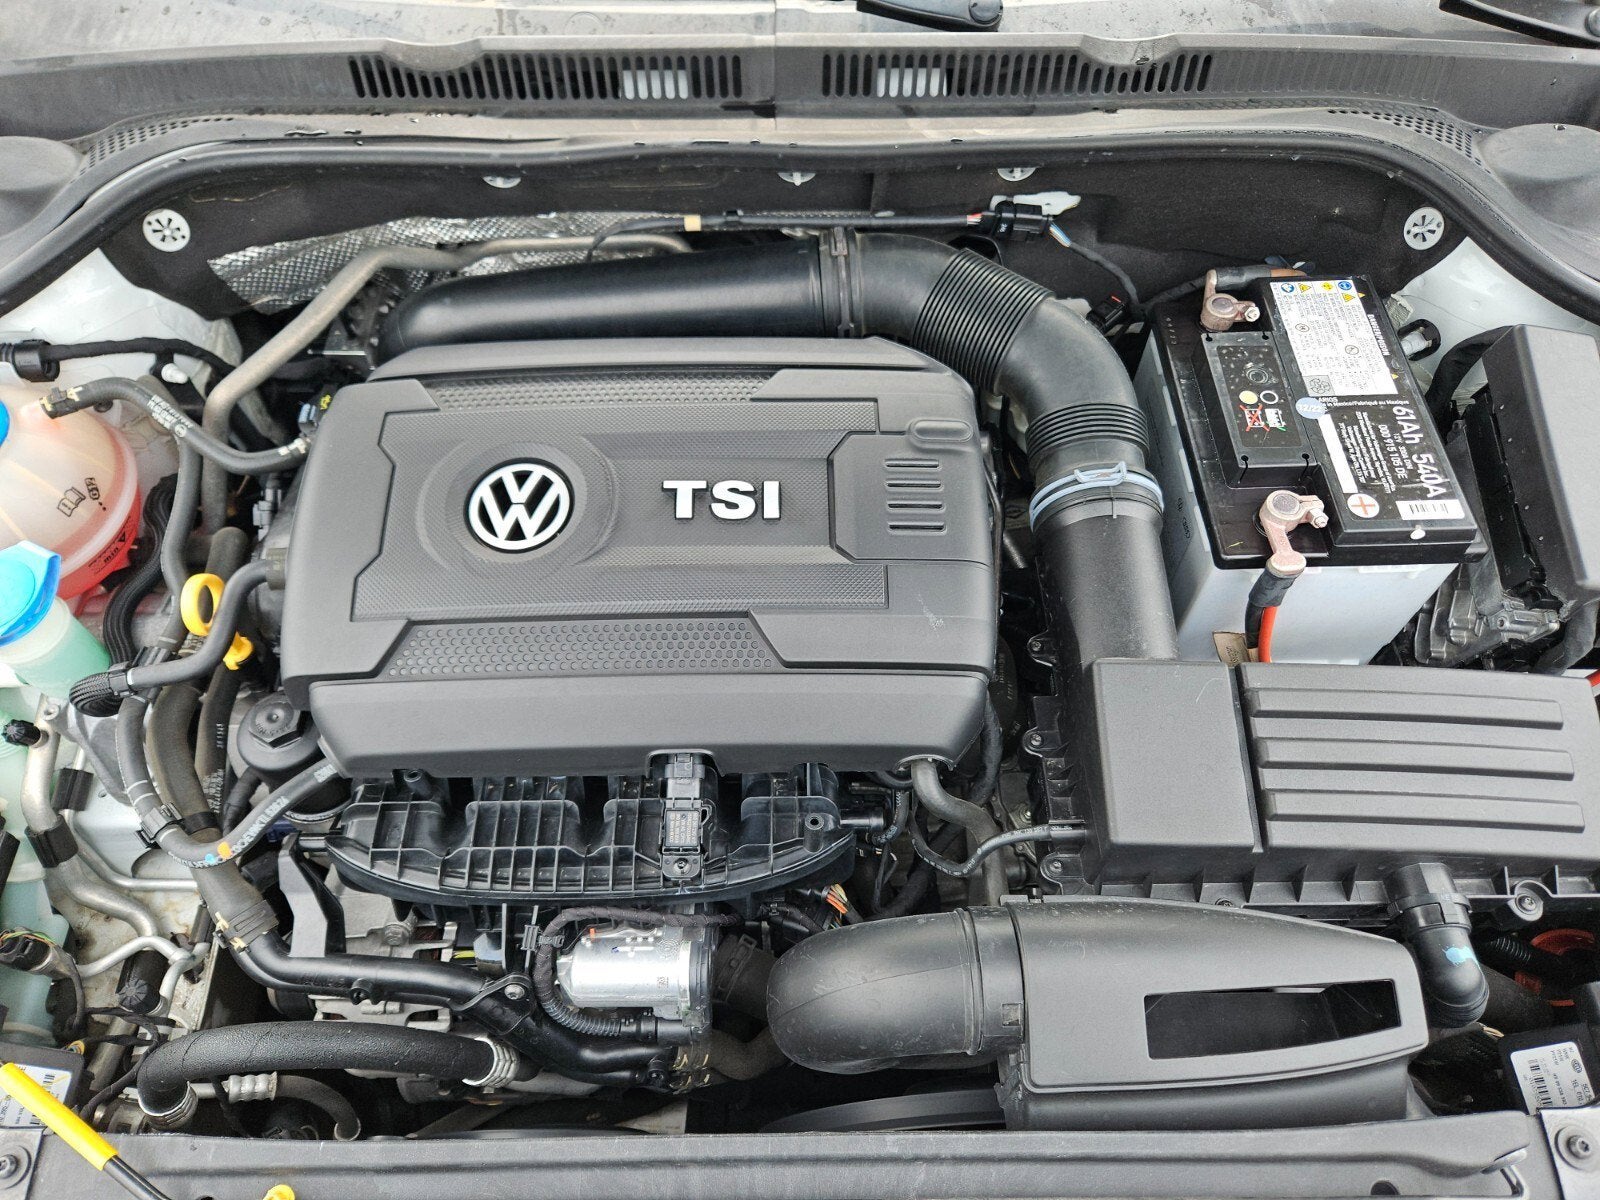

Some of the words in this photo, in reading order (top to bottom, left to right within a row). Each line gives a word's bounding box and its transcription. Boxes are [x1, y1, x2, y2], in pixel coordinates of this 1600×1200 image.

[1383, 438, 1397, 452] 915
[1392, 406, 1424, 444] 61Ah
[1412, 453, 1448, 498] 540A
[1390, 453, 1403, 466] 105
[1395, 467, 1408, 479] DE
[662, 480, 780, 520] TSI
